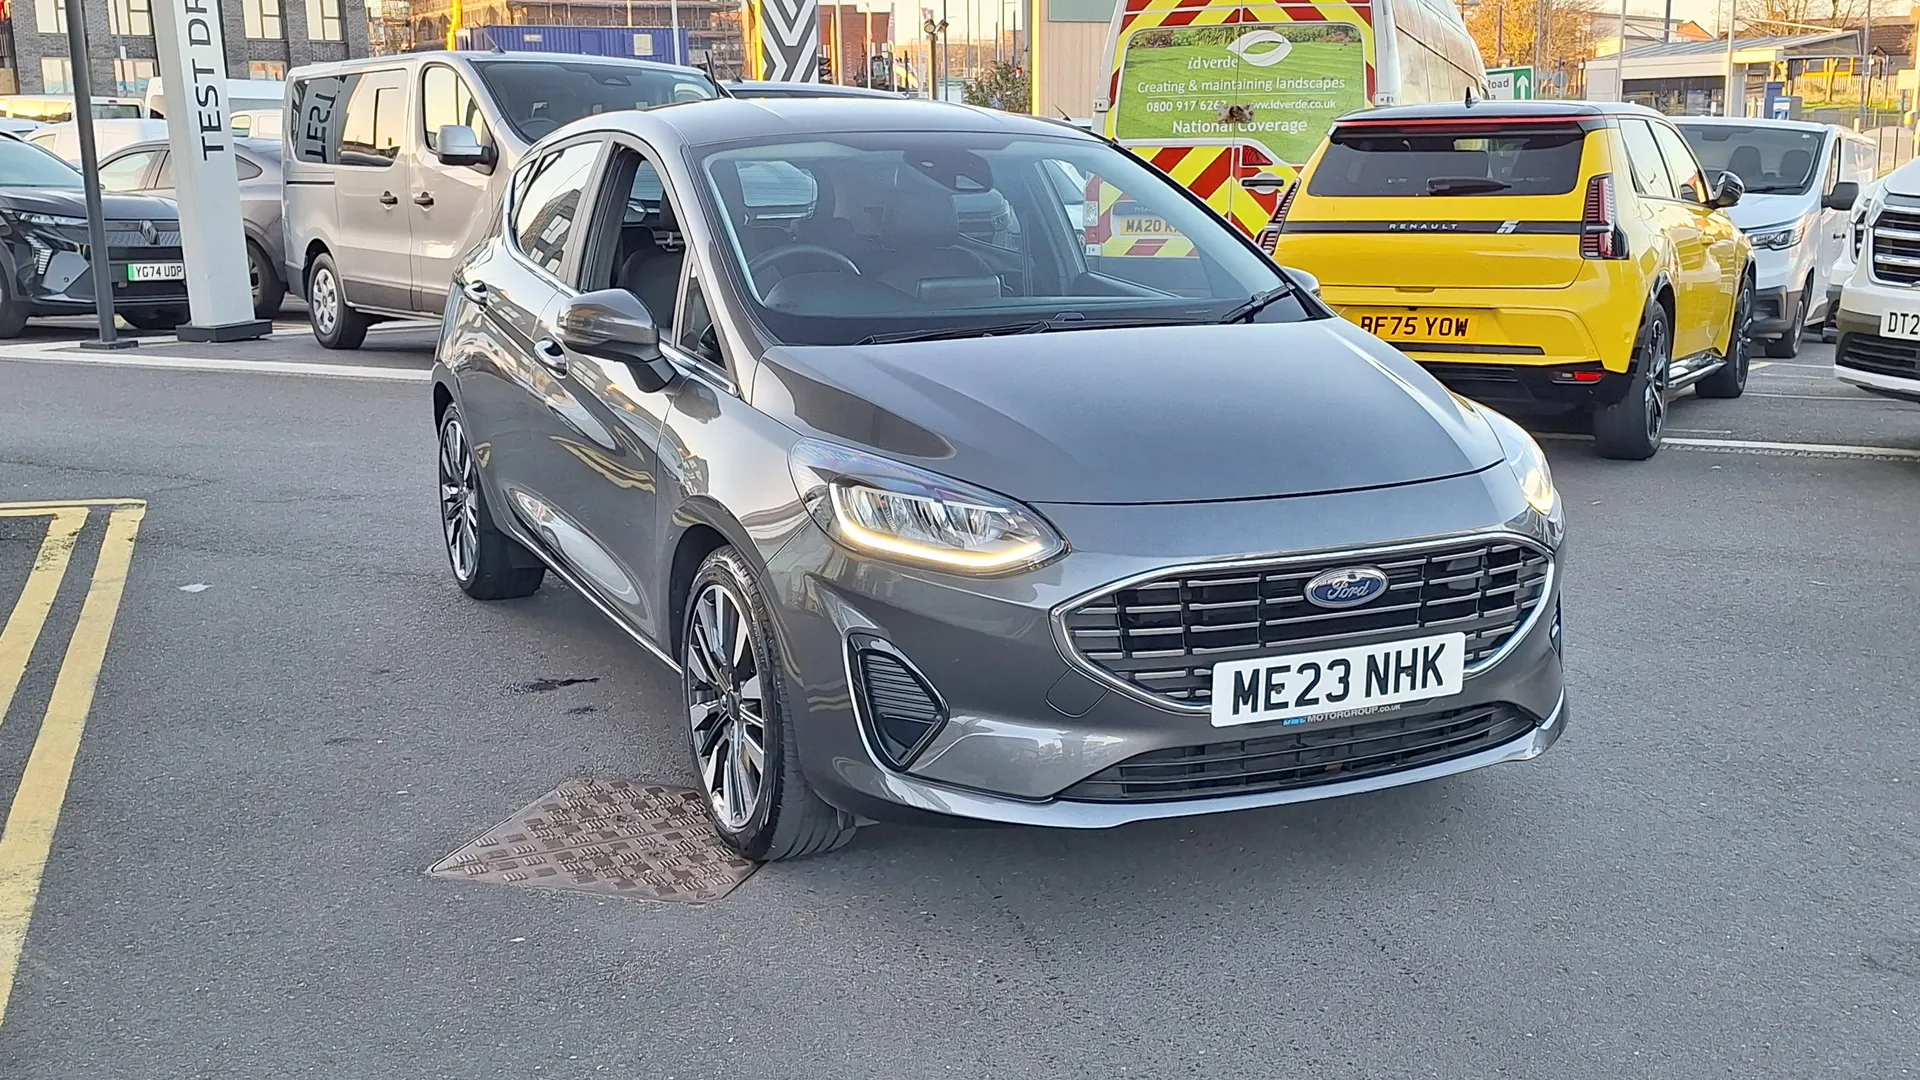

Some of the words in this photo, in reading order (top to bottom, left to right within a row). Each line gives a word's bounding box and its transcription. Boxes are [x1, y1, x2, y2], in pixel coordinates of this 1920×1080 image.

[1137, 80, 1185, 94] Creating
[1188, 79, 1198, 91] &
[1201, 78, 1272, 92] maintaining
[1276, 76, 1345, 90] landscapes
[191, 57, 225, 161] TEST
[1146, 101, 1173, 112] 0800
[1176, 100, 1197, 111] 917
[1244, 99, 1336, 109] ww.idverde.co.uk
[1172, 120, 1233, 133] National
[1237, 120, 1308, 134] Coverage
[1125, 219, 1162, 232] MA20
[135, 266, 162, 278] YG74
[163, 265, 182, 277] UDP
[1360, 316, 1418, 336] BF75
[1425, 316, 1469, 337] YOW
[1326, 579, 1371, 600] Ford
[1232, 658, 1352, 716] ME23
[1364, 642, 1446, 698] NHK
